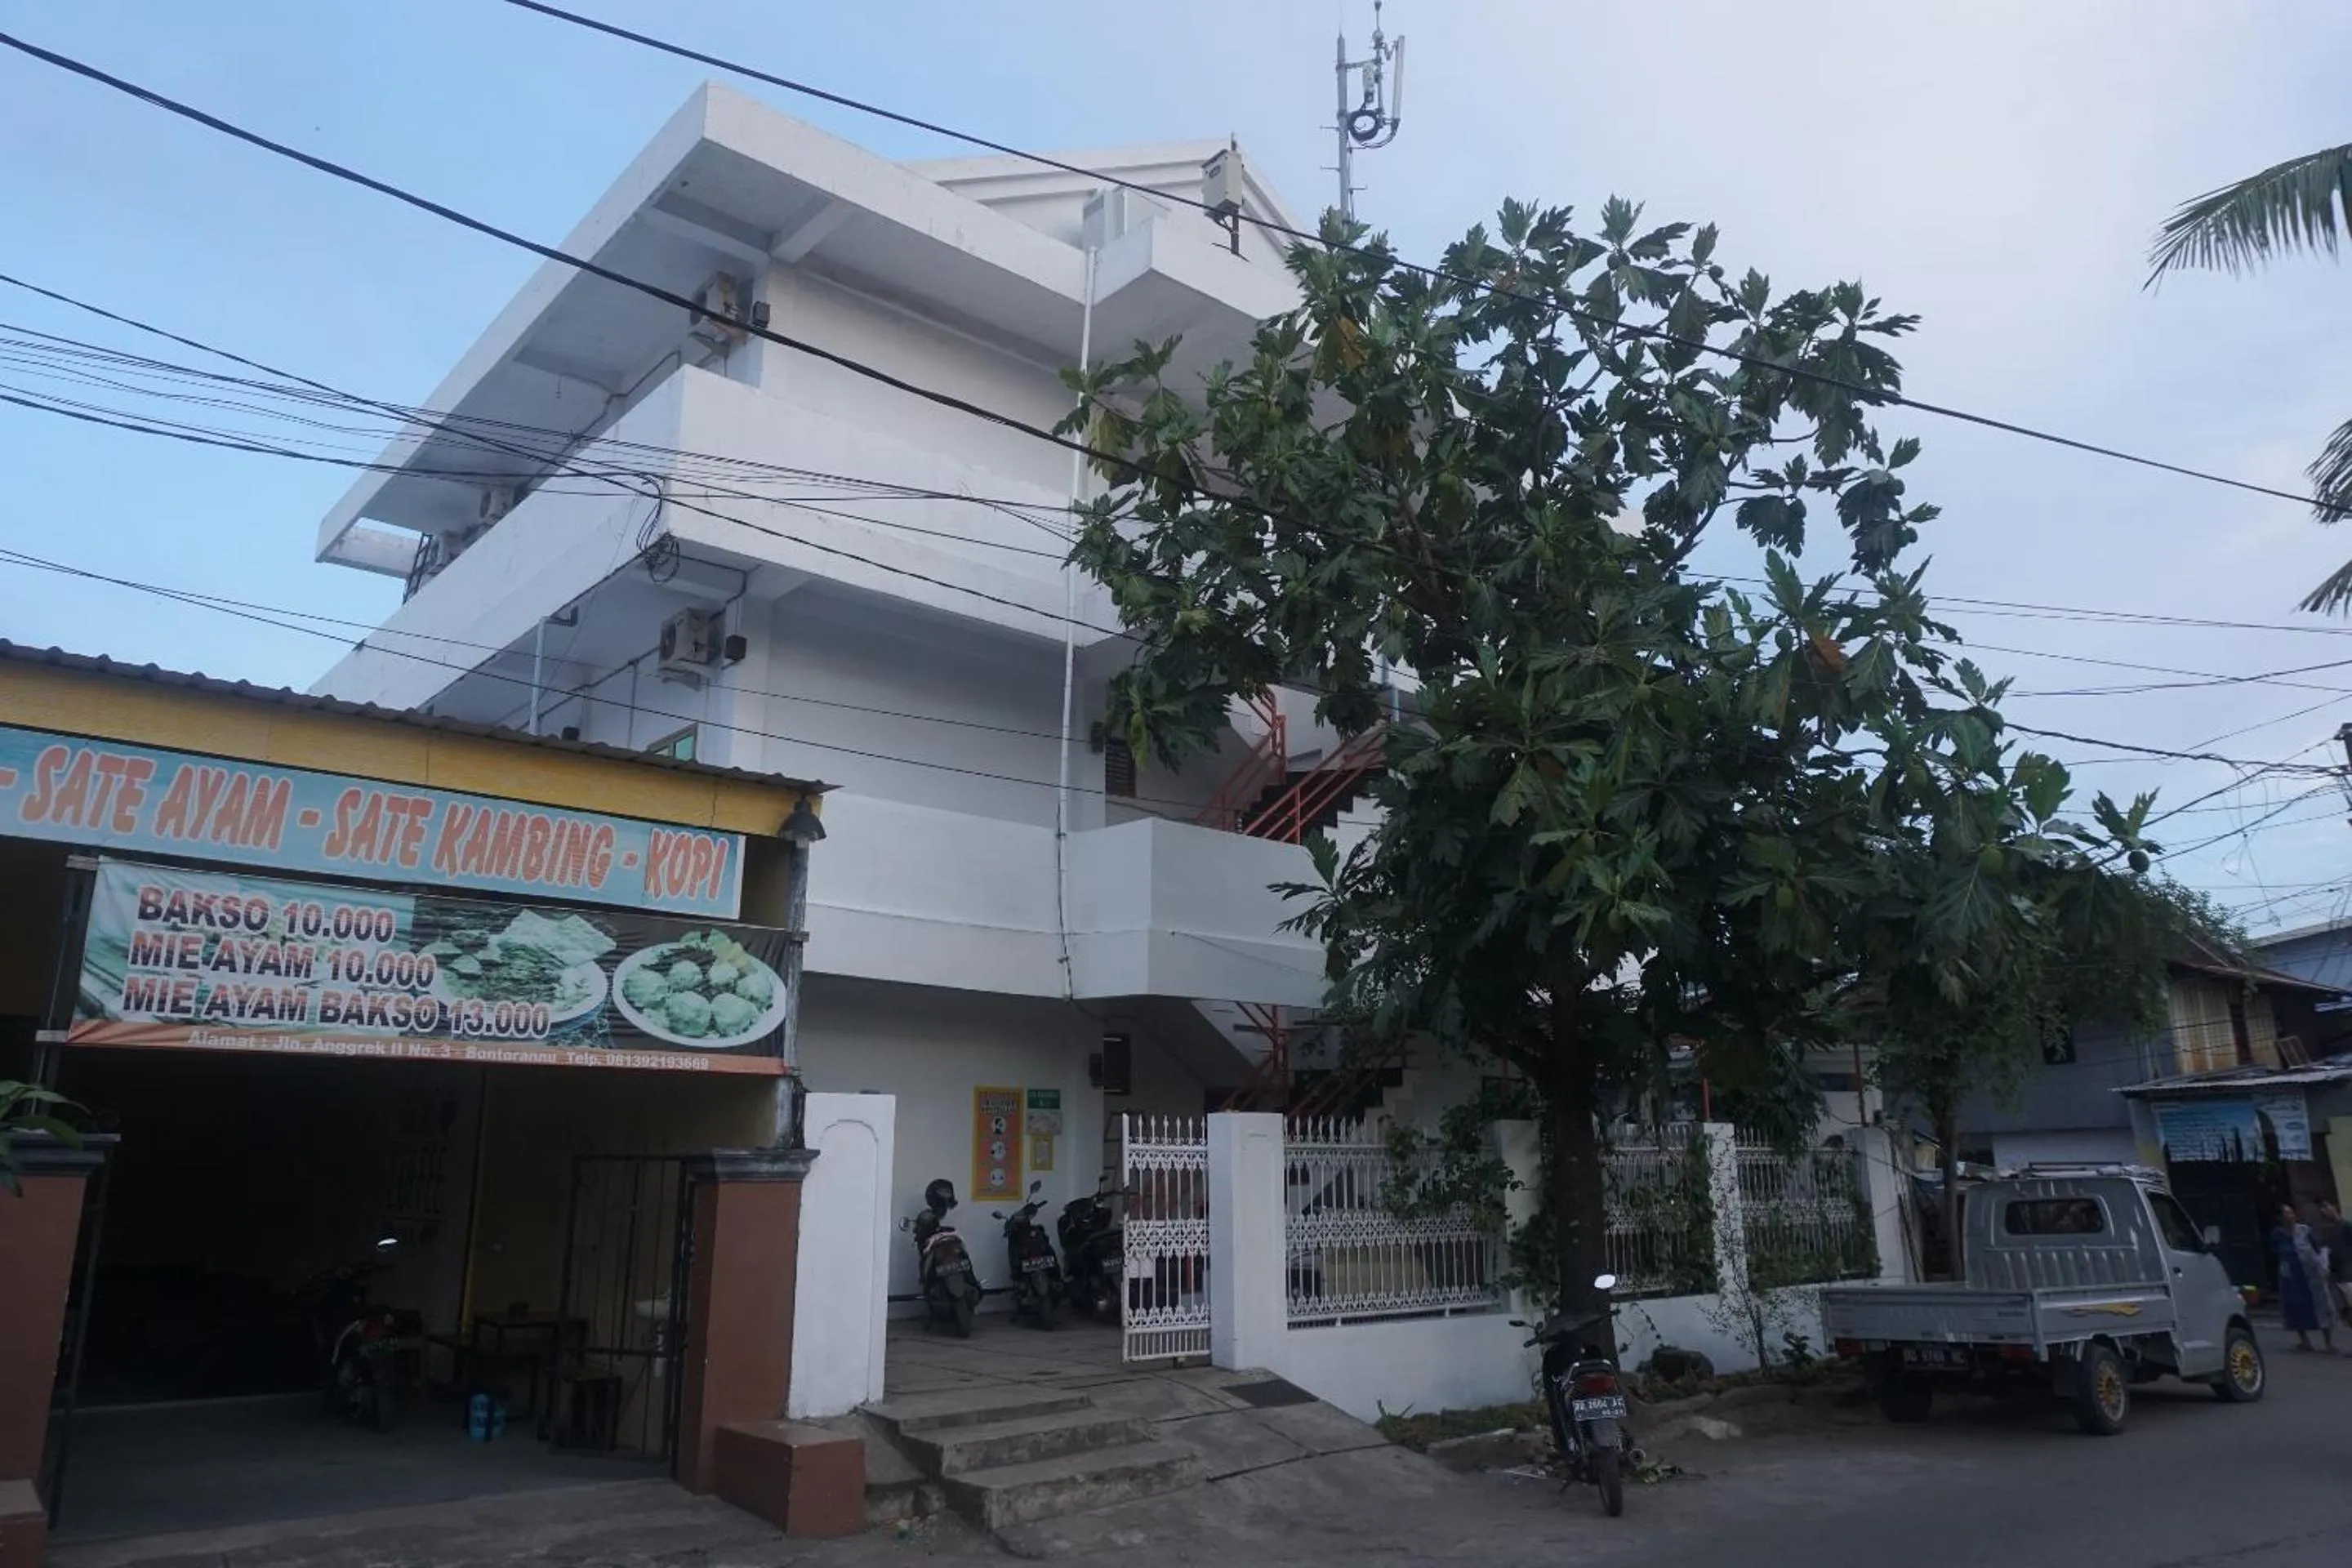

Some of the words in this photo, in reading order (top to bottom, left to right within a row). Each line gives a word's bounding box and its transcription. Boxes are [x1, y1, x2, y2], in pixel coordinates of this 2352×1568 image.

[21, 746, 156, 834] SATE
[154, 764, 292, 851] AYAM
[323, 787, 434, 869] SATE
[433, 801, 616, 889] KAMBING
[644, 828, 729, 899] KOPI
[137, 884, 270, 933] BAKSO
[283, 901, 395, 942] 10.000
[128, 931, 204, 970] MIE
[209, 937, 315, 980] AYAM
[327, 947, 436, 989] 10.000
[122, 977, 195, 1016] MIE
[203, 981, 310, 1023] AYAM
[318, 988, 439, 1032] BAKSO
[450, 997, 551, 1039] 13.000
[188, 1030, 255, 1048] Alamat
[311, 1038, 386, 1056] Anggrek
